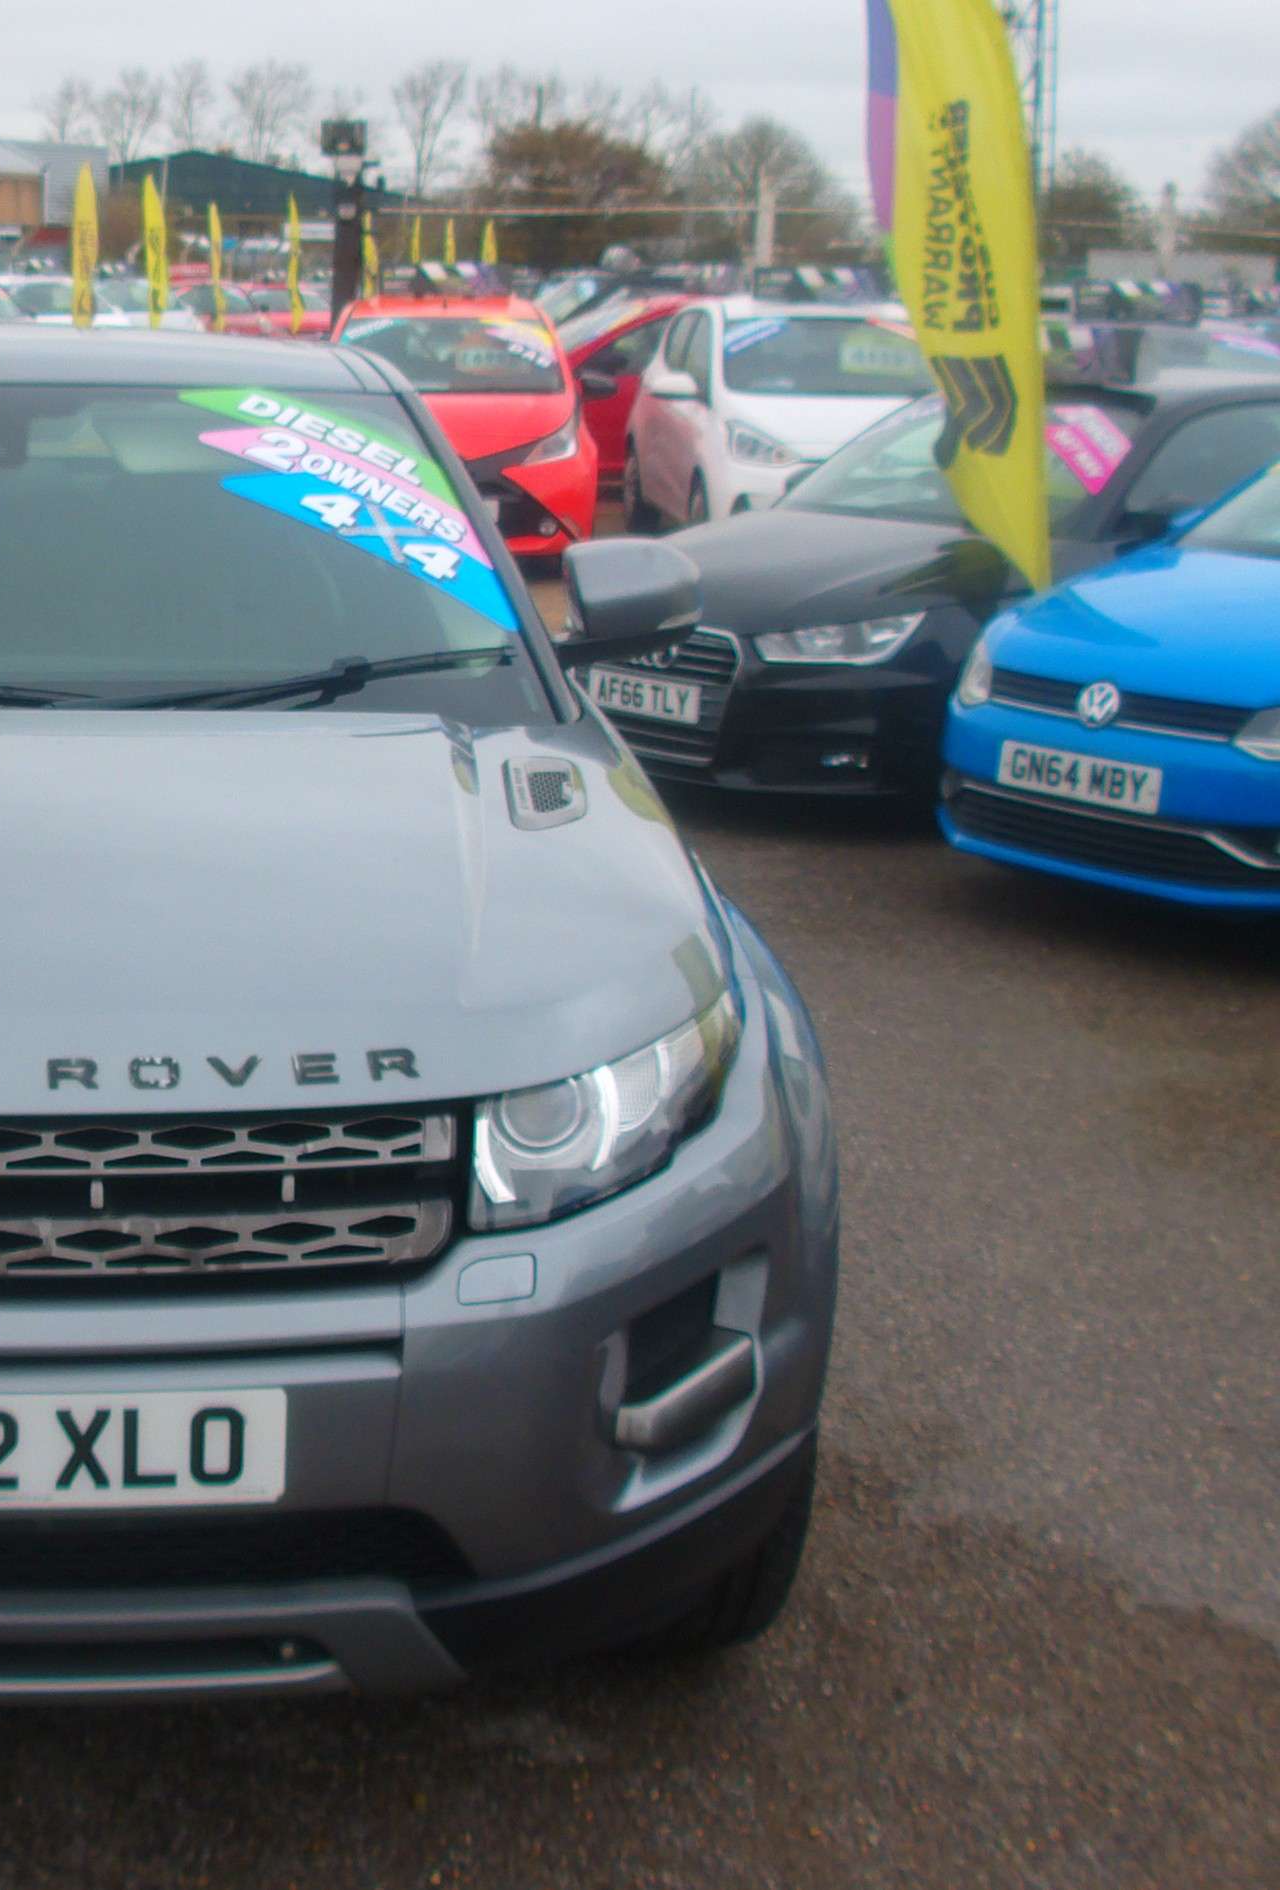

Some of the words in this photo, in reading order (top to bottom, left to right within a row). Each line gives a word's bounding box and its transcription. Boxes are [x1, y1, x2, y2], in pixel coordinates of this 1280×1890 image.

[237, 393, 423, 487] DIESEL
[243, 430, 308, 472] 2
[300, 454, 466, 543] OWNERS
[598, 673, 645, 708] AF66
[651, 684, 690, 717] TLY
[1010, 748, 1081, 791] GN64
[1089, 762, 1149, 803] MBY
[46, 1047, 422, 1092] ROVER
[54, 1406, 246, 1490] XLO
